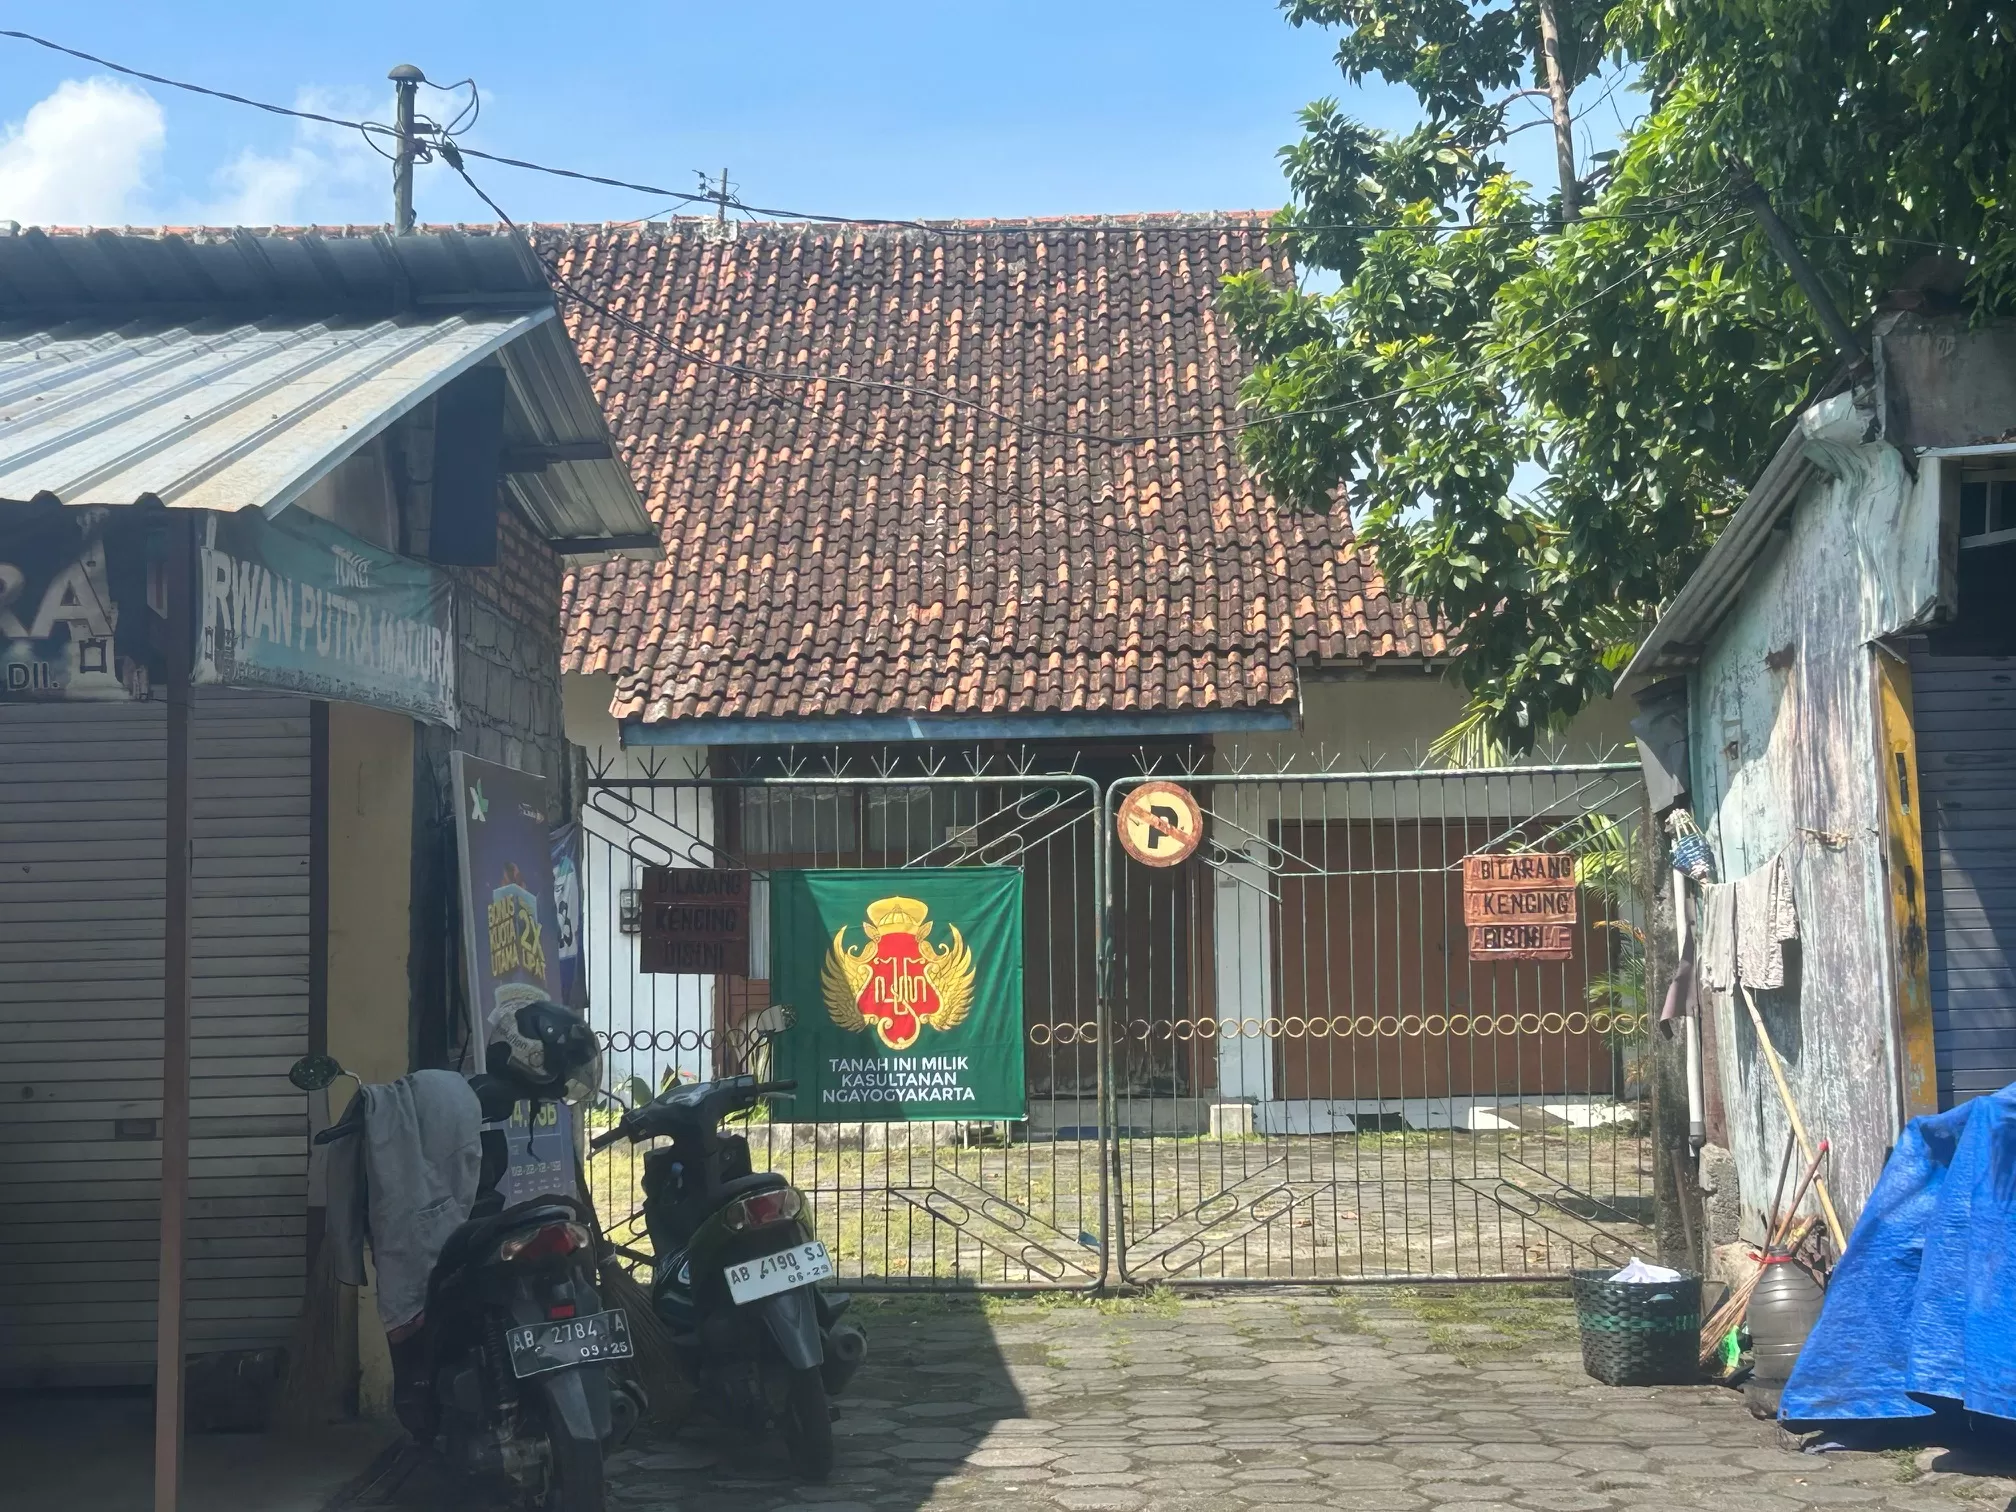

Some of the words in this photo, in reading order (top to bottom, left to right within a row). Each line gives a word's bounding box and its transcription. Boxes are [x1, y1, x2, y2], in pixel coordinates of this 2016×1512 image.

[299, 583, 374, 668] PUTRA
[829, 1058, 888, 1073] TANAH
[893, 1057, 916, 1072] INI
[921, 1056, 968, 1071] MILIK
[841, 1071, 957, 1088] KASULTANAN
[823, 1087, 976, 1103] NGAYOGYAKARTA
[731, 1266, 750, 1285] AB
[760, 1252, 797, 1276] 4190
[804, 1243, 824, 1261] SJ
[513, 1330, 534, 1352] AB
[550, 1319, 598, 1344] 2784
[614, 1313, 626, 1332] A
